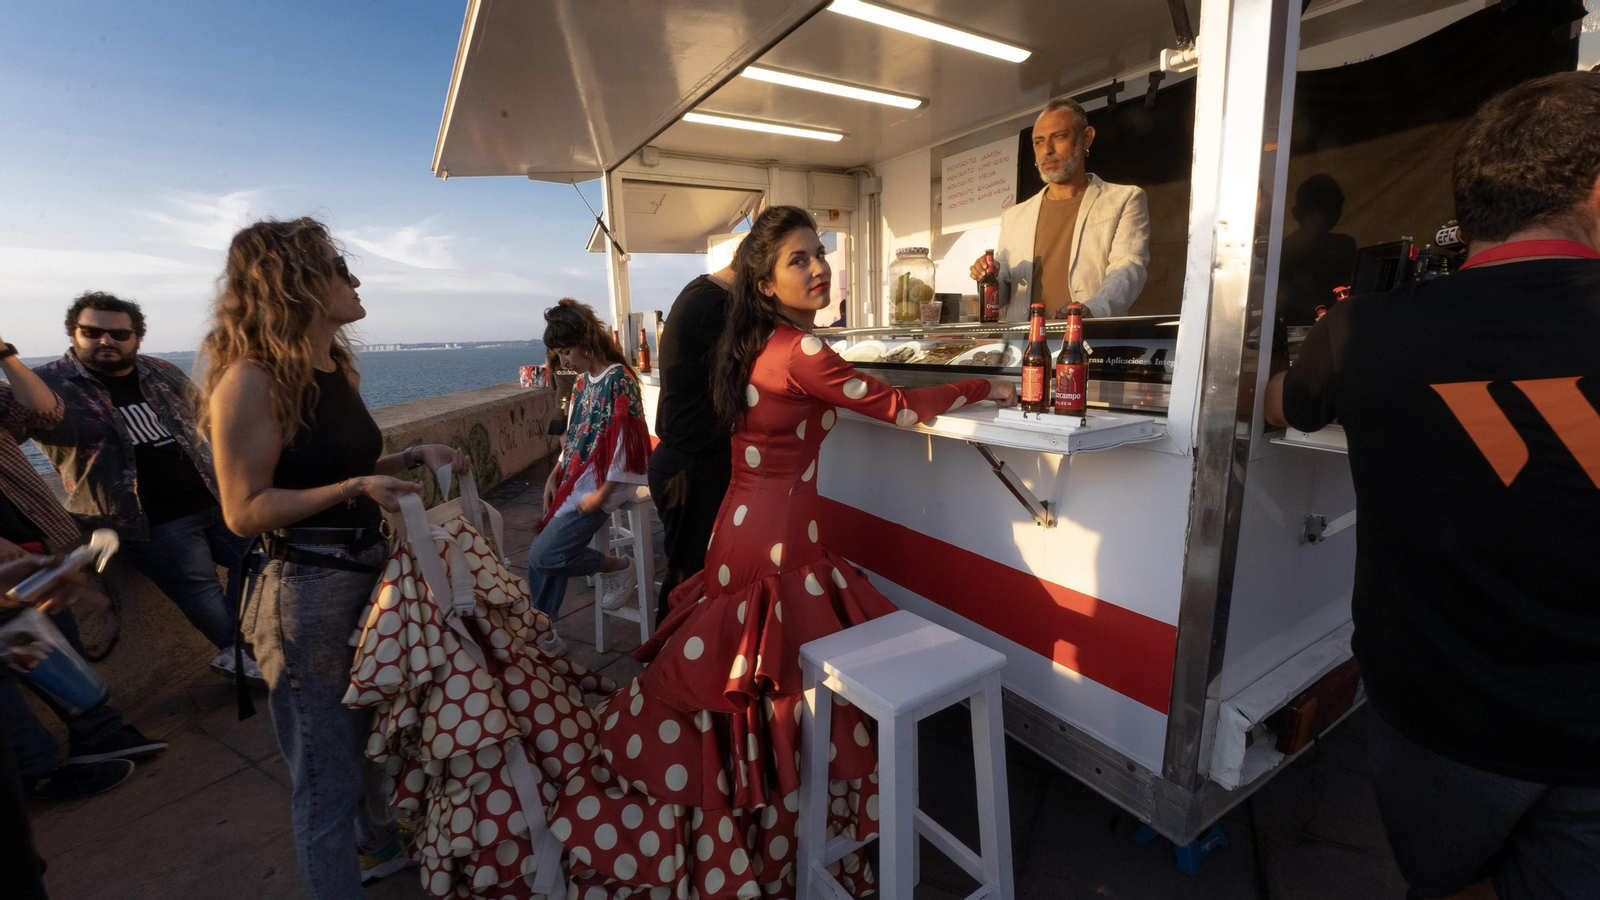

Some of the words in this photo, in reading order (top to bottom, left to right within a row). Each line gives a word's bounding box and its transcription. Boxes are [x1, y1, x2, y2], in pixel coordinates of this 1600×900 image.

[946, 157, 977, 173] MONTADITO
[981, 149, 1002, 162] JAMÓN
[946, 167, 975, 182] MONTADITO
[947, 177, 974, 191] MONTADITO
[978, 170, 997, 180] MELVA
[947, 188, 974, 200] MONTADITO
[947, 197, 975, 210] MONTADITO
[978, 191, 993, 200] CARNE
[1105, 356, 1151, 366] Aplicaciones
